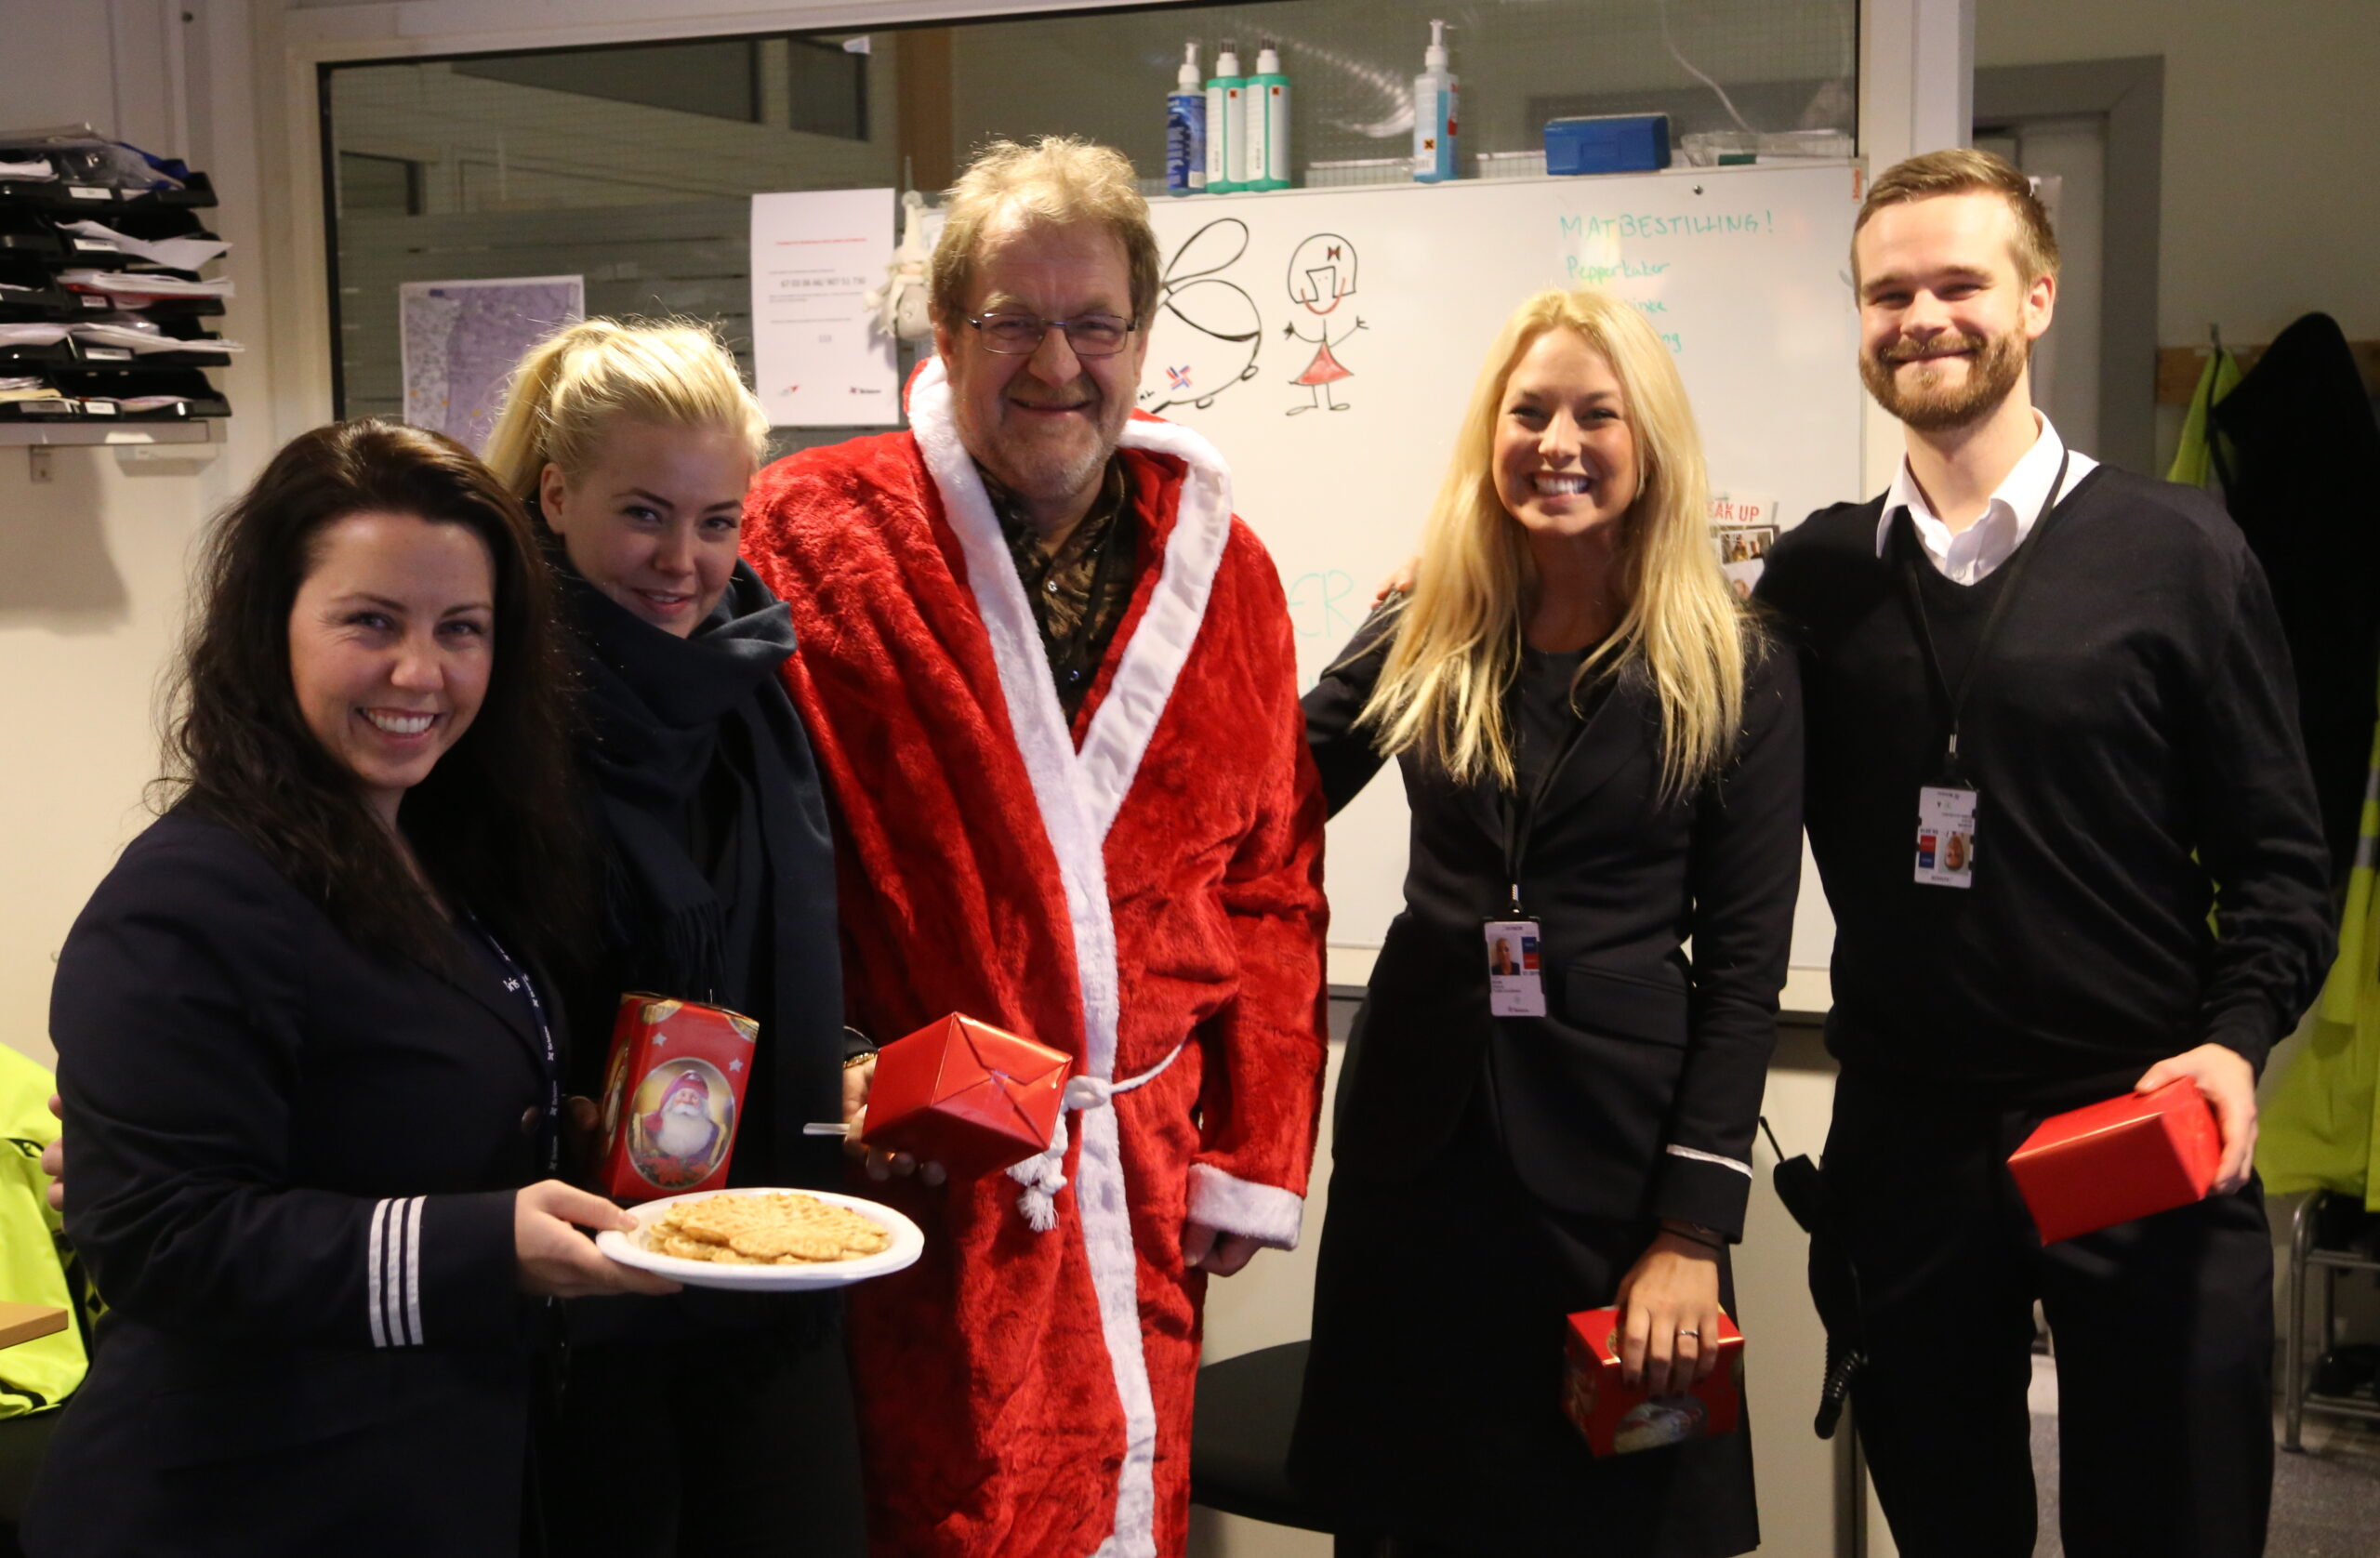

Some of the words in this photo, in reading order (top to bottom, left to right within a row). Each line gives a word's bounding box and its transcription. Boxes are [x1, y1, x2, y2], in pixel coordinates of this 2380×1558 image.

[1560, 210, 1774, 238] MATBESTILLING!
[1739, 505, 1760, 522] UP
[1289, 568, 1358, 640] ER
